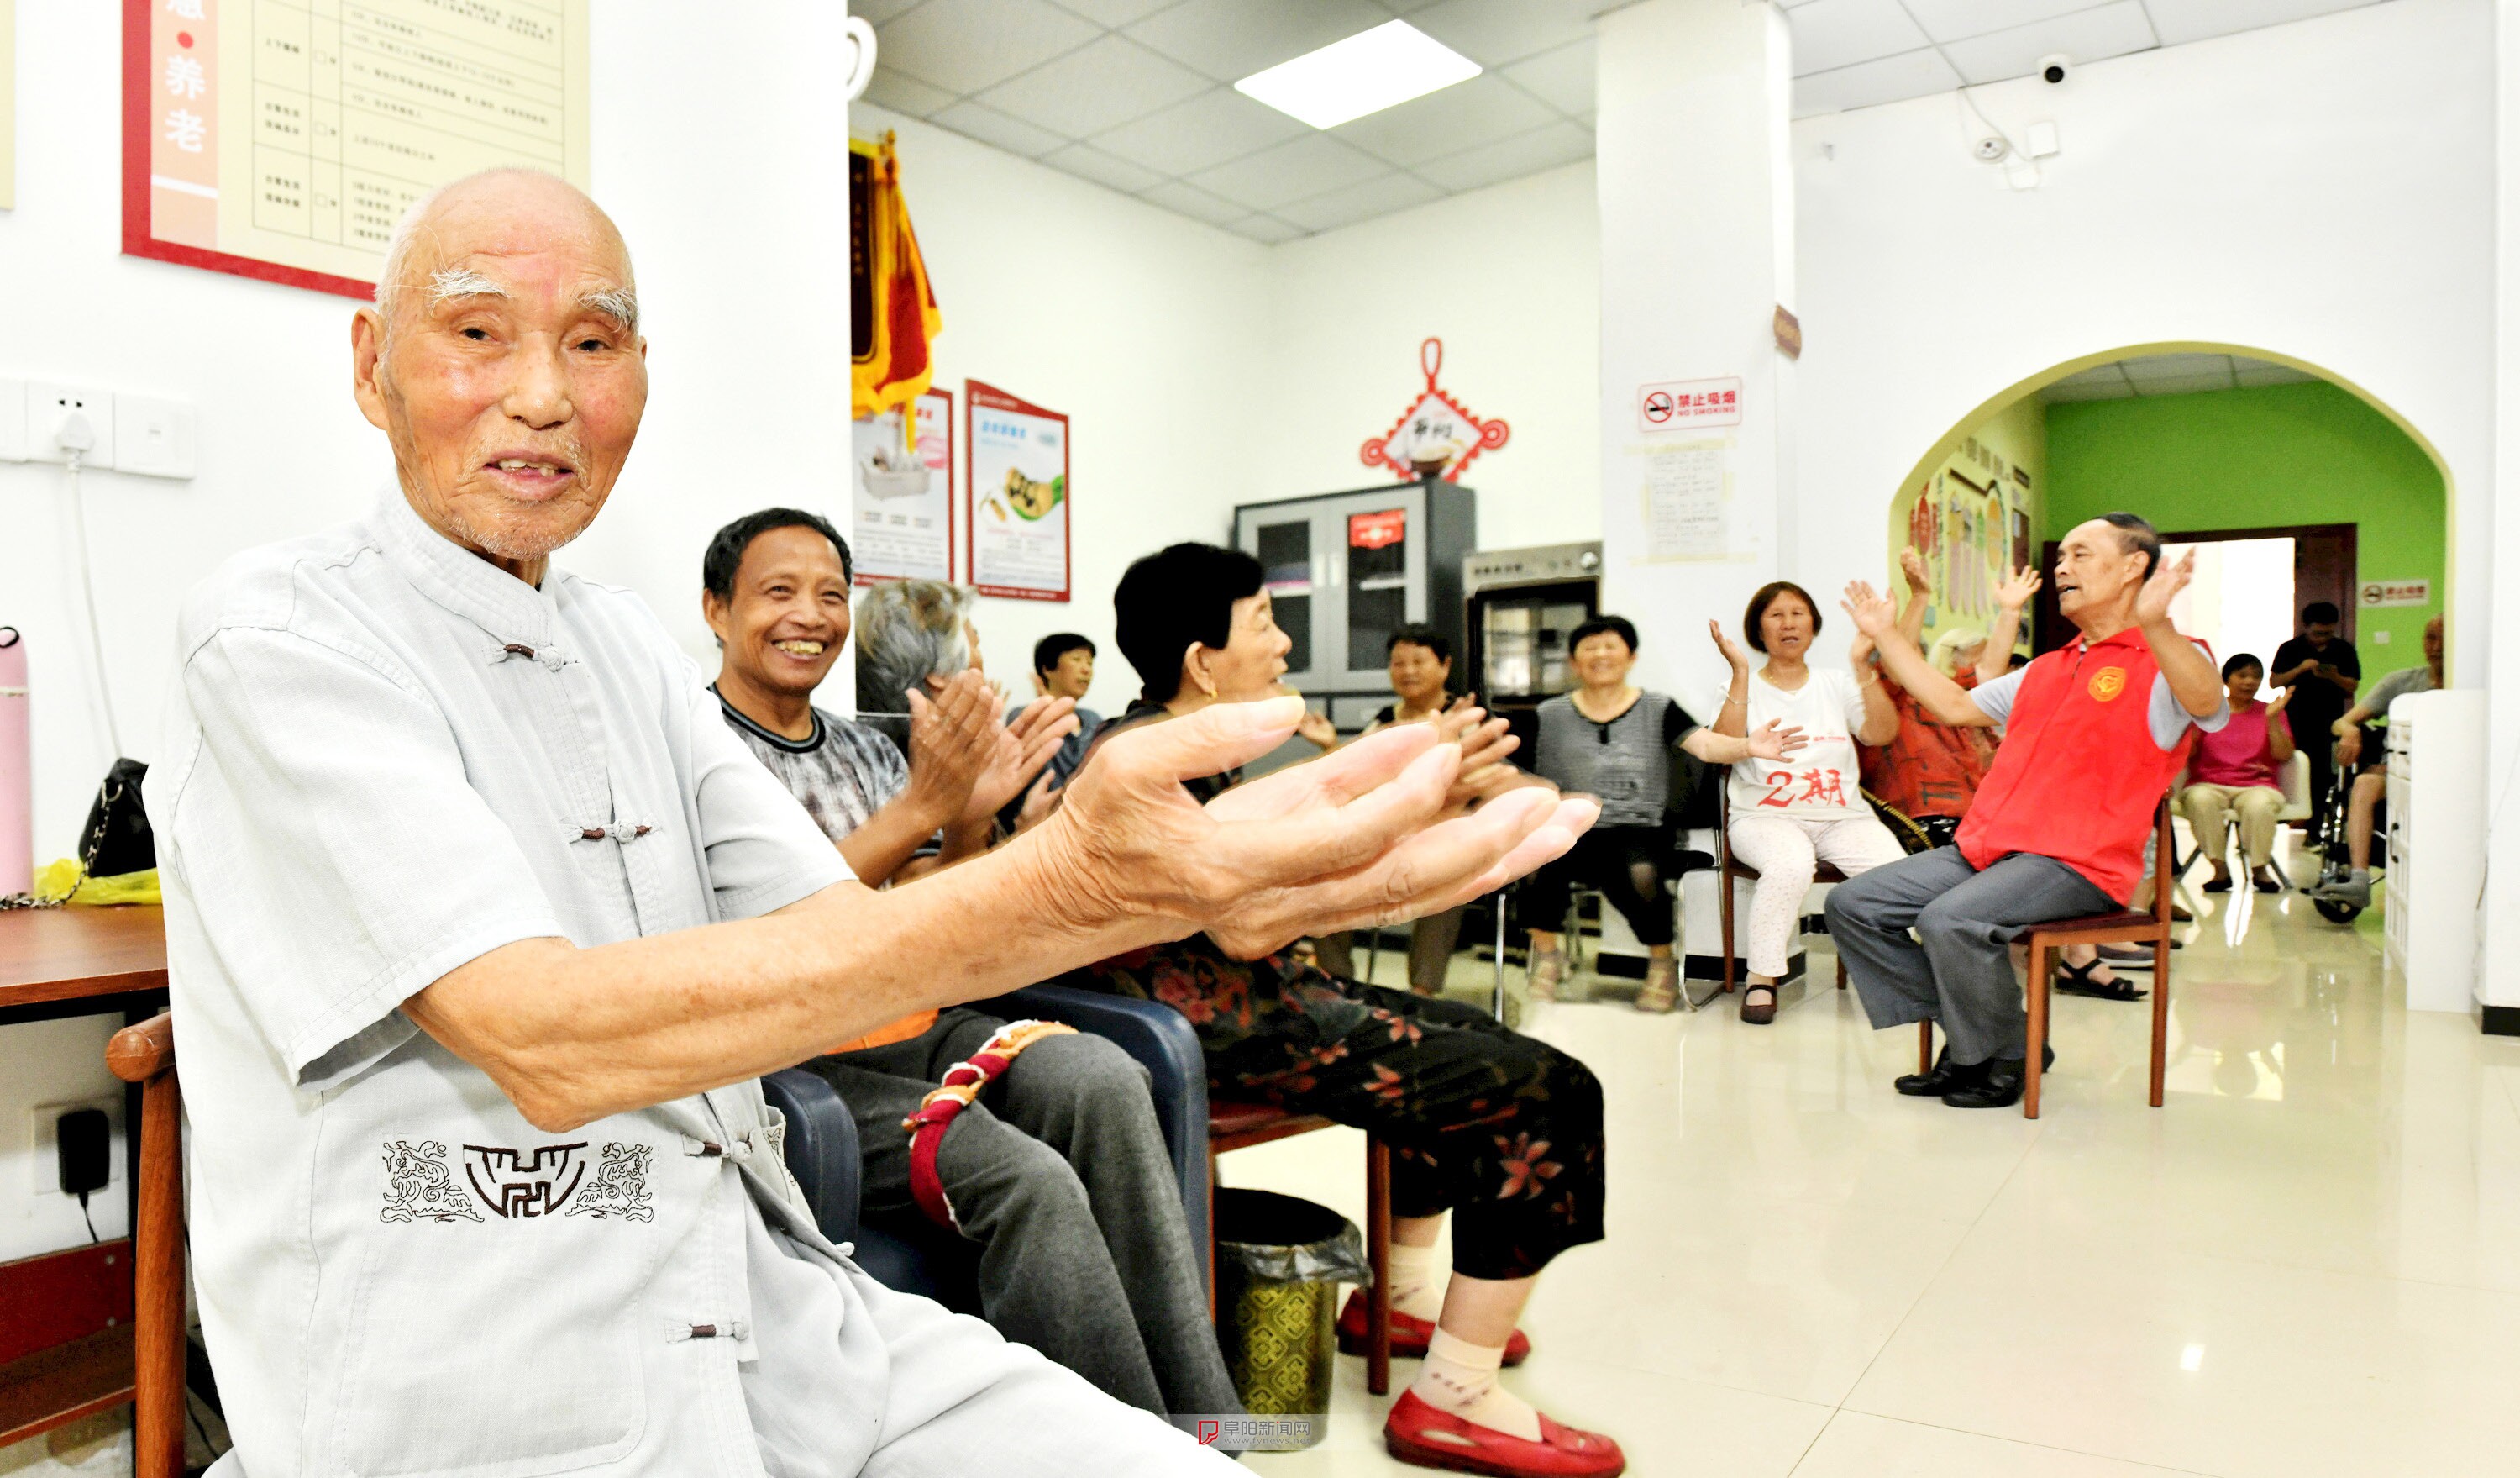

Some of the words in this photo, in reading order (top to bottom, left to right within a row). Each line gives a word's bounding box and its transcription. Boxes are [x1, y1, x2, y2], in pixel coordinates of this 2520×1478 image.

[165, 54, 207, 154] 养老
[1677, 390, 1735, 408] 禁止吸烟
[1693, 405, 1735, 416] SMOKING
[1756, 768, 1846, 807] 2期
